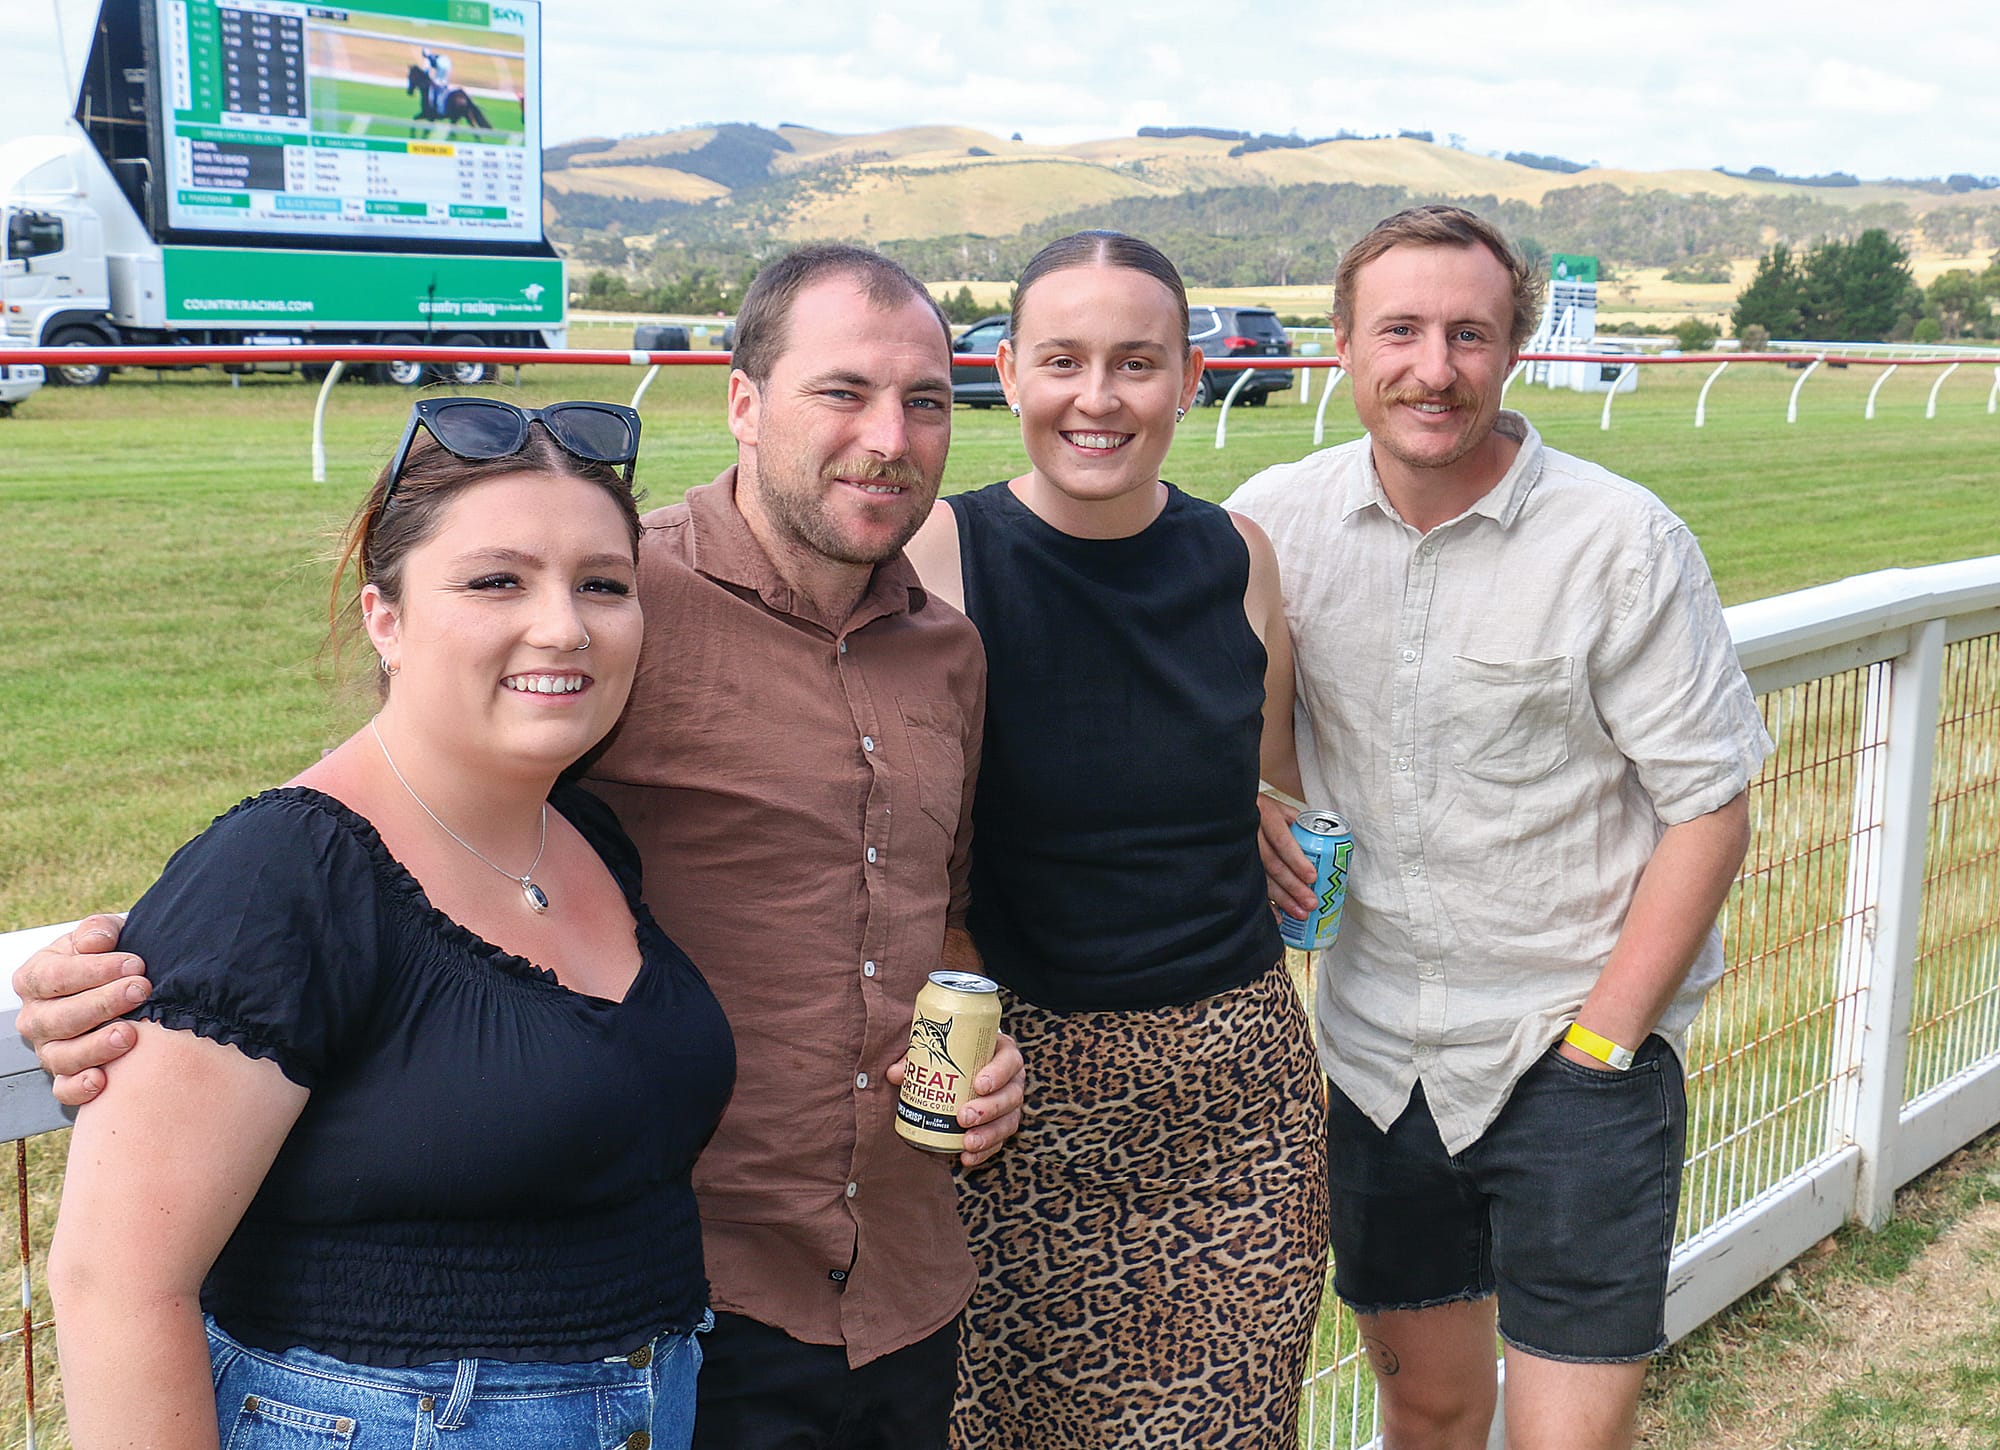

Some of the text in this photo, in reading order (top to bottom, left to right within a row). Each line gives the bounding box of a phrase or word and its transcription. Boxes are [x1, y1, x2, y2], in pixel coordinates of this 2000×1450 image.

[183, 299, 314, 312] COUNTRYRACING.COM
[418, 300, 460, 316] country
[461, 300, 497, 316] racing
[903, 1077, 956, 1104] ORTHERN
[905, 1109, 923, 1123] CRISP
